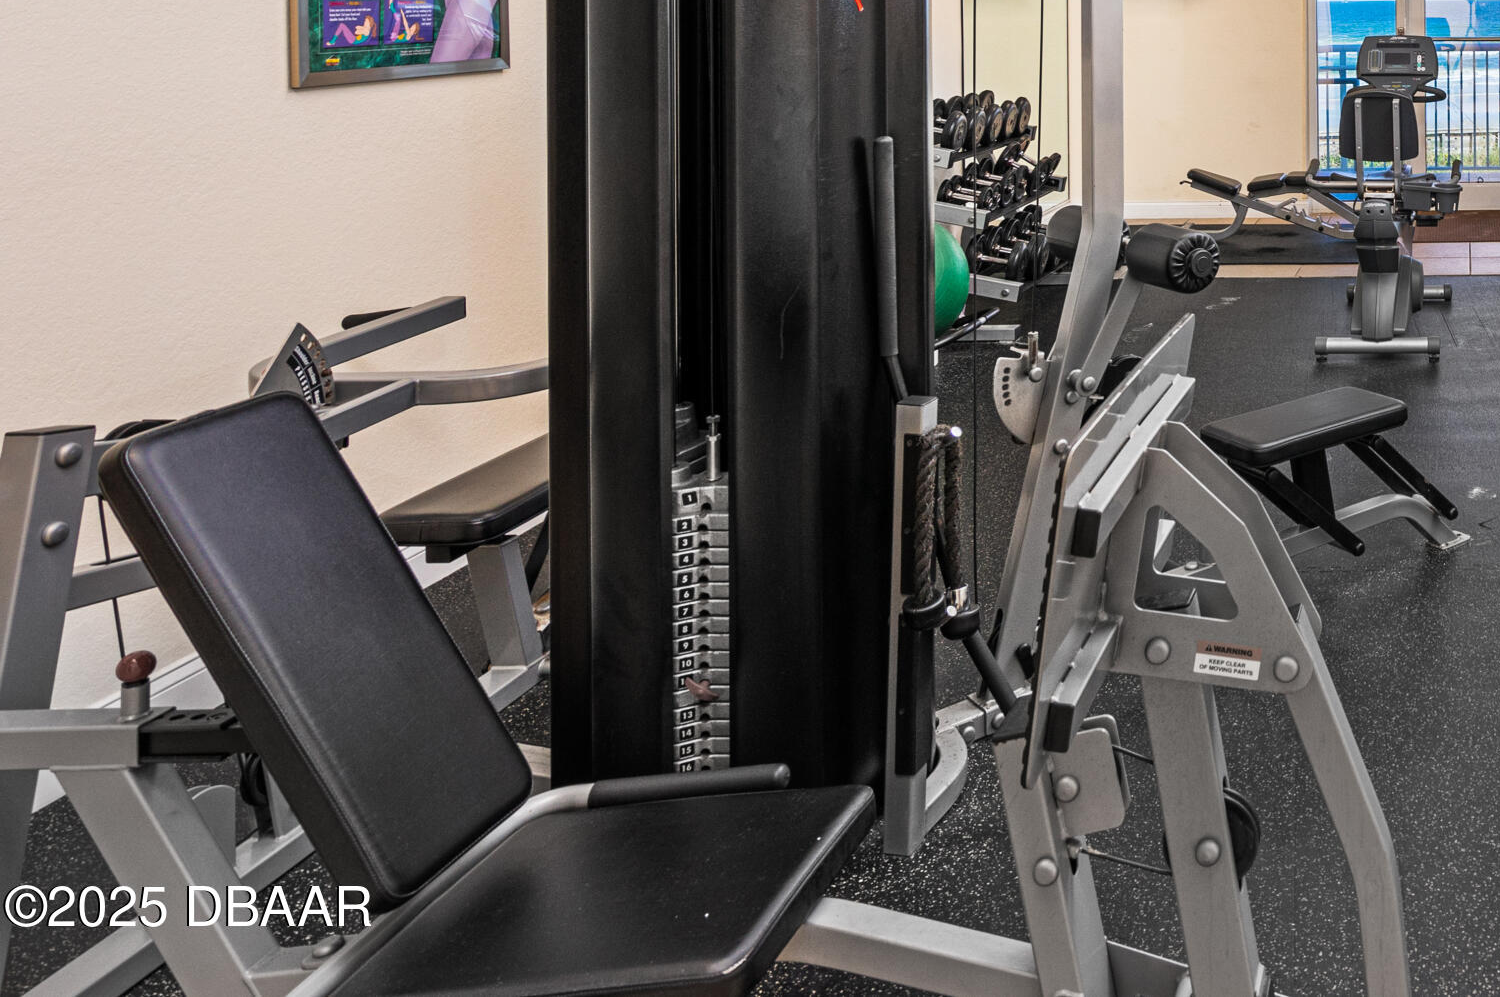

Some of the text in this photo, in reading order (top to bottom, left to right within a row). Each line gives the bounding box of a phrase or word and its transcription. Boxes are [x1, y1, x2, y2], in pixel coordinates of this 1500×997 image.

[1213, 645, 1253, 657] WARNING
[1225, 660, 1246, 668] CLEAR
[1208, 665, 1233, 674] MOVING
[1233, 668, 1253, 676] PARTS
[682, 711, 693, 720] 13
[681, 729, 692, 738] 14
[681, 746, 692, 755] 15
[681, 763, 692, 772] 16
